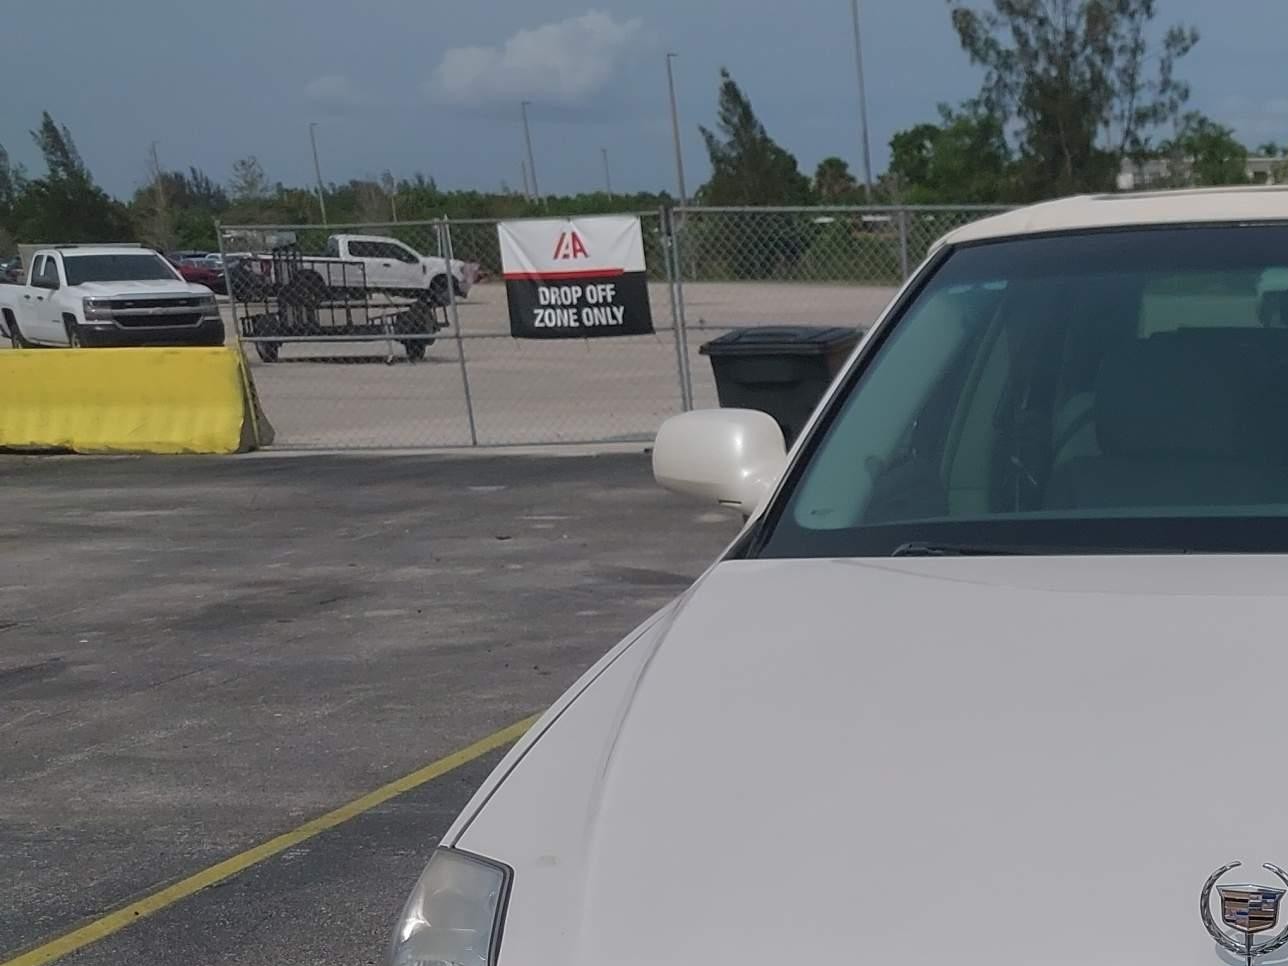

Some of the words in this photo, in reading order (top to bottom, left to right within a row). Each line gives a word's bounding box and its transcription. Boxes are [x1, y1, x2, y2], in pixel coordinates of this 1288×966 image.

[538, 285, 582, 306] DROP
[586, 283, 616, 304] OFF
[533, 308, 580, 328] ZONE
[582, 306, 625, 327] ONLY
